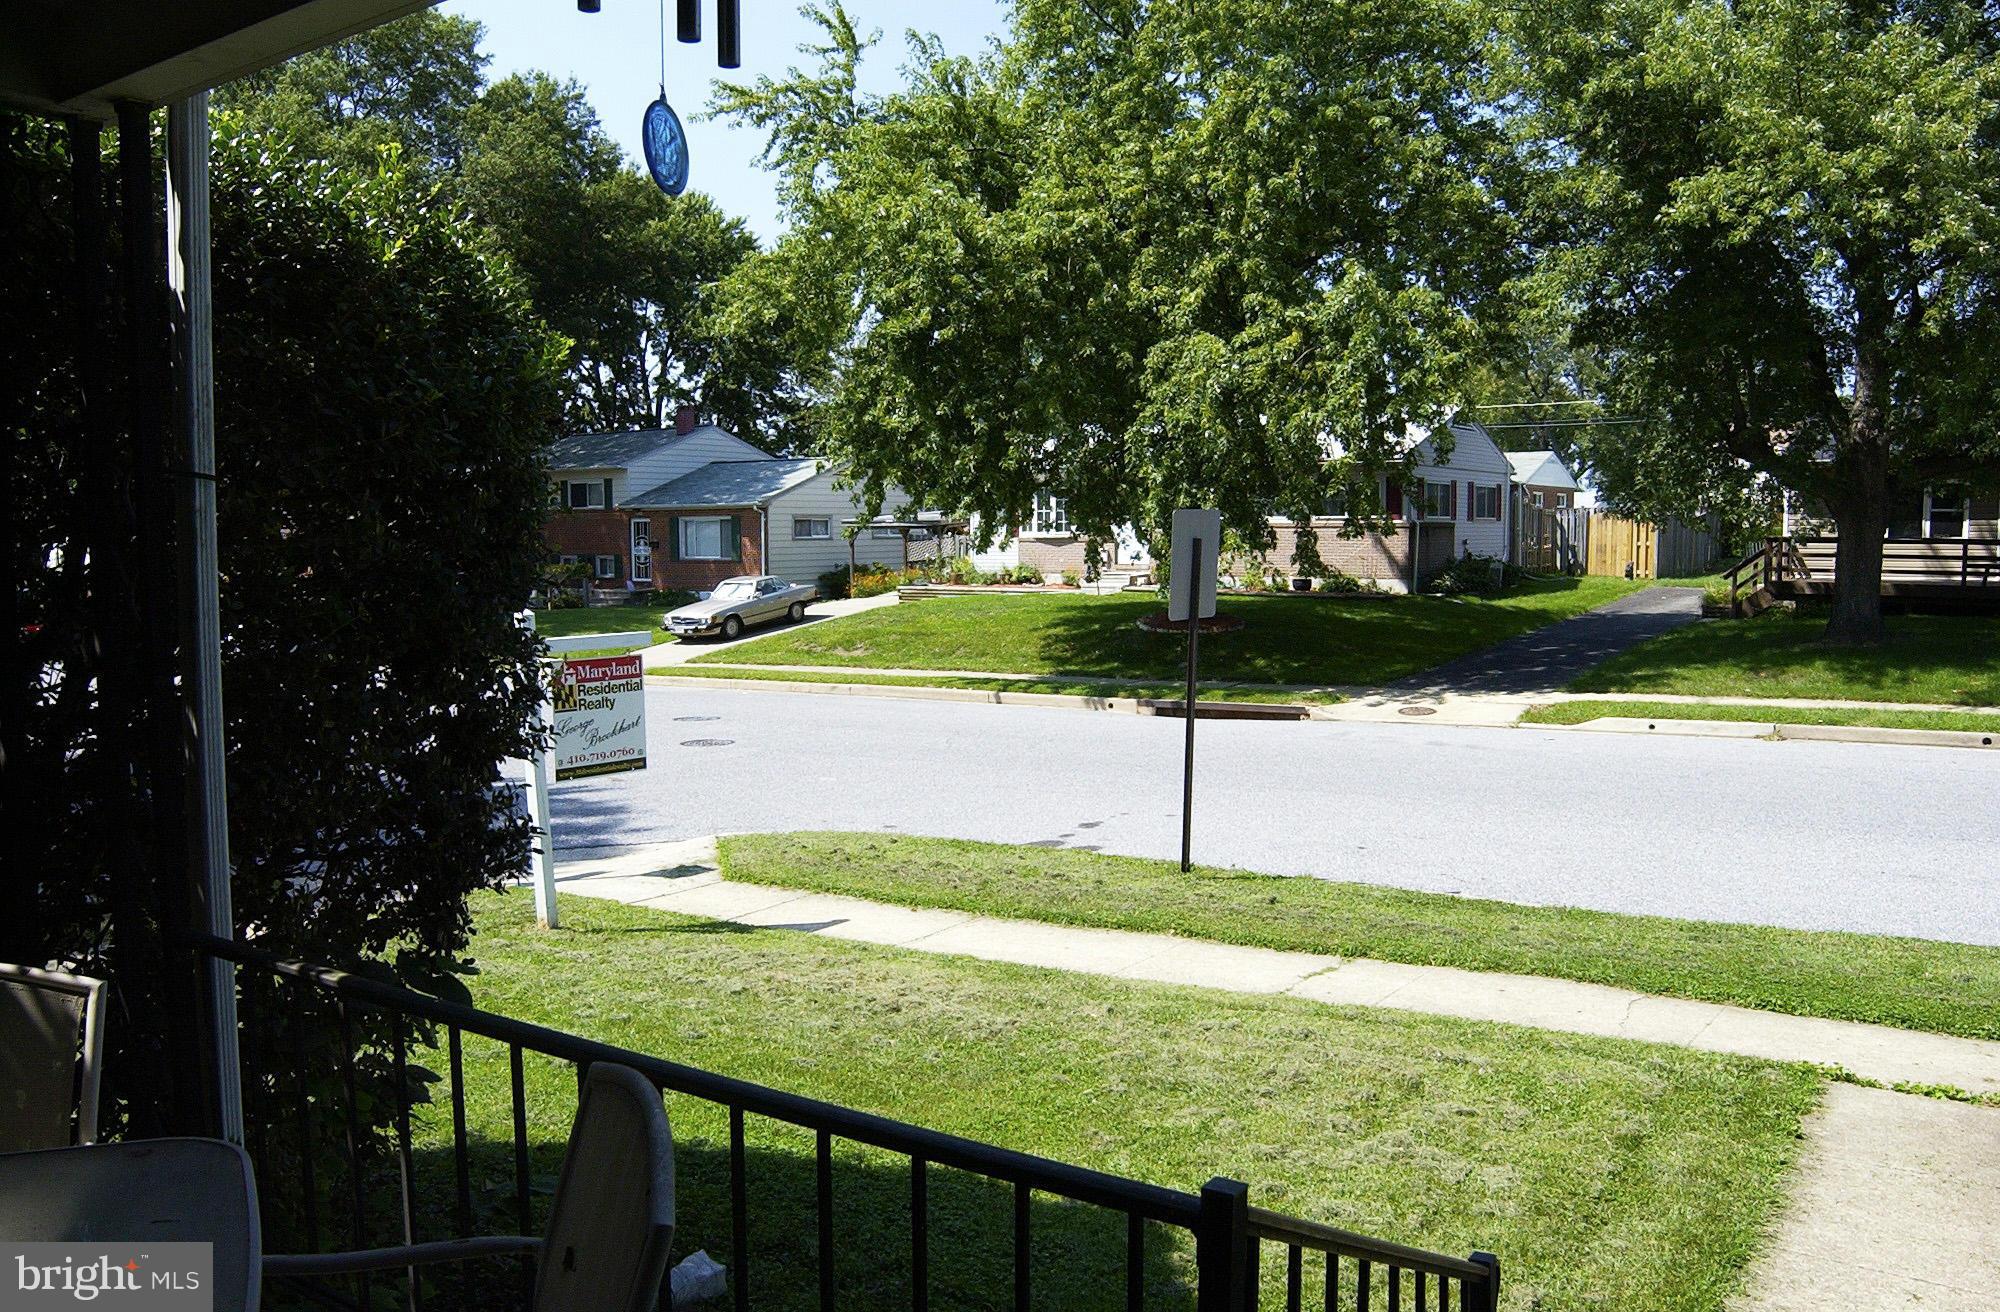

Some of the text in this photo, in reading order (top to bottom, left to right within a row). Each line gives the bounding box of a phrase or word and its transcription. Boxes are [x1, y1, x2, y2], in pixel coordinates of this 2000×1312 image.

[577, 660, 641, 679] Maryland
[577, 679, 643, 697] Residential
[578, 697, 616, 711] Realty
